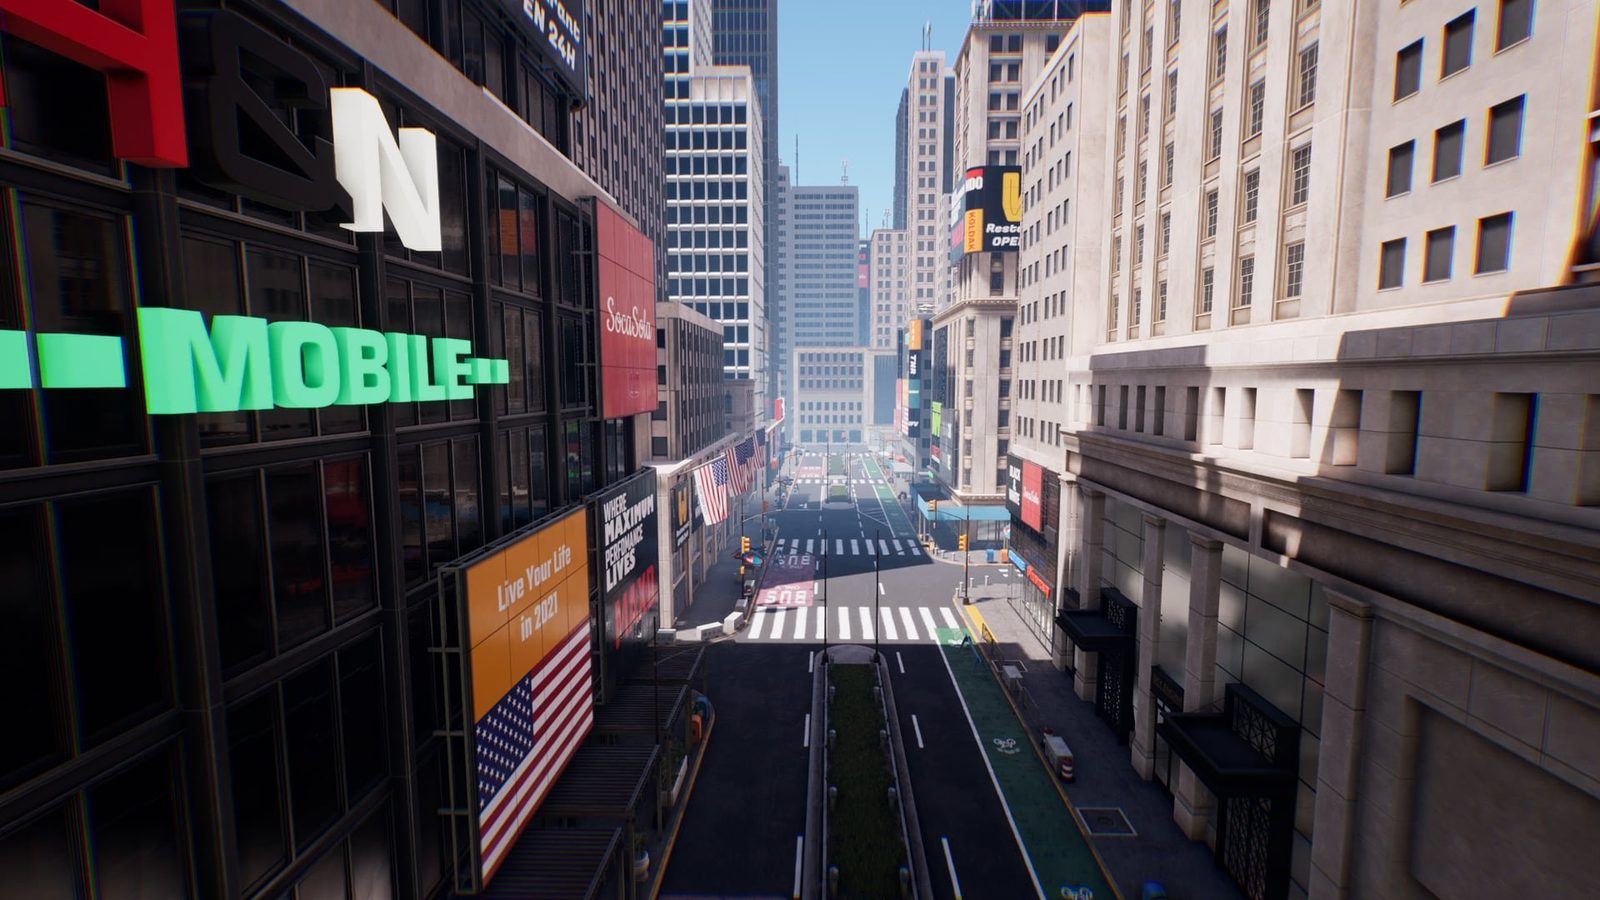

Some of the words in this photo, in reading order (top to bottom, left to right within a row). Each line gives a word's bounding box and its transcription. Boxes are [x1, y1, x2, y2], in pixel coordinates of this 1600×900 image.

[548, 20, 576, 71] 24H
[992, 236, 1019, 246] OPE
[606, 296, 652, 340] SocaSola
[603, 492, 627, 522] WHERE
[604, 494, 654, 547] MAXIMUM
[497, 579, 524, 612] Live
[526, 559, 551, 591] Your
[553, 545, 572, 573] Life
[606, 548, 636, 592] LIVES
[520, 615, 533, 642] in
[534, 591, 558, 630] 2021
[767, 590, 807, 604] BUS
